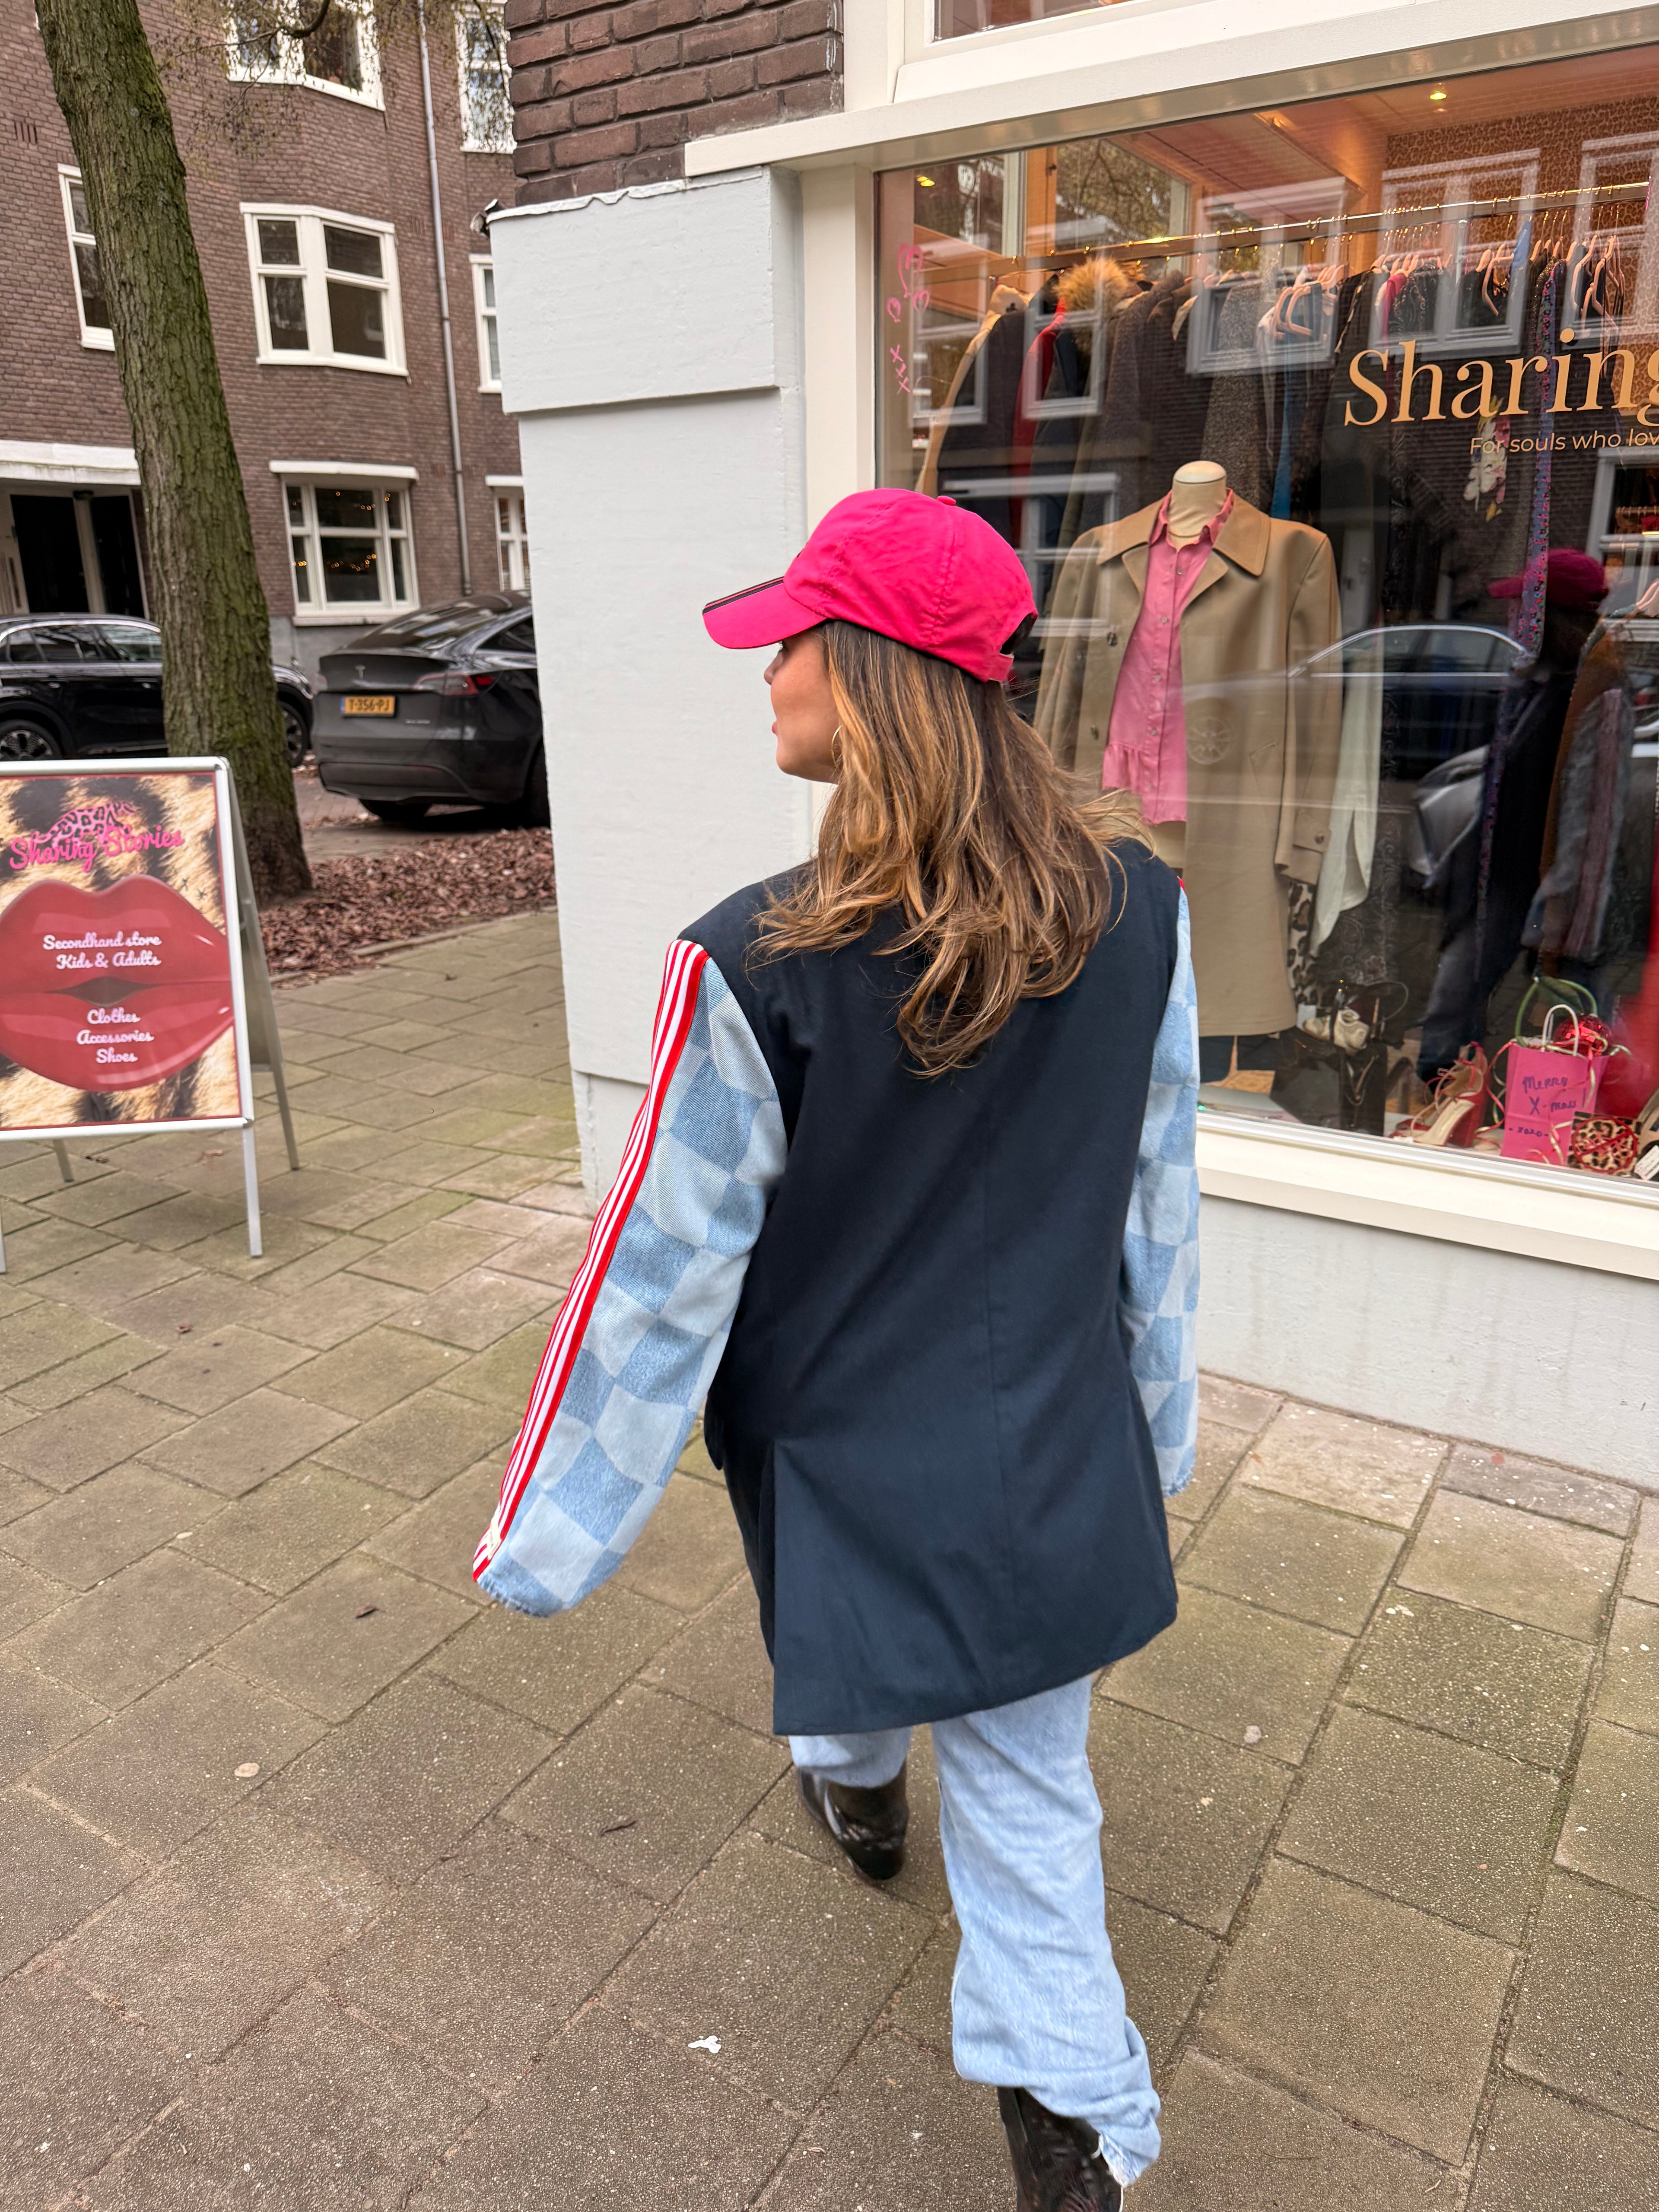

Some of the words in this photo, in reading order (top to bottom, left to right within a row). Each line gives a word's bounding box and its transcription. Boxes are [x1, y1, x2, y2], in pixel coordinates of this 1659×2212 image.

[1470, 437, 1505, 455] For
[1510, 432, 1567, 453] souls
[1572, 430, 1621, 450] who
[9, 831, 98, 873] Sharing
[102, 824, 186, 857] Stories
[43, 930, 124, 950] Secondhand
[125, 931, 162, 947] store
[56, 952, 93, 969] Kids
[94, 952, 109, 968] &
[112, 950, 162, 967] Adults
[87, 1007, 141, 1025] Clothes
[76, 1029, 155, 1045] Accessories
[95, 1046, 139, 1064] Shoes
